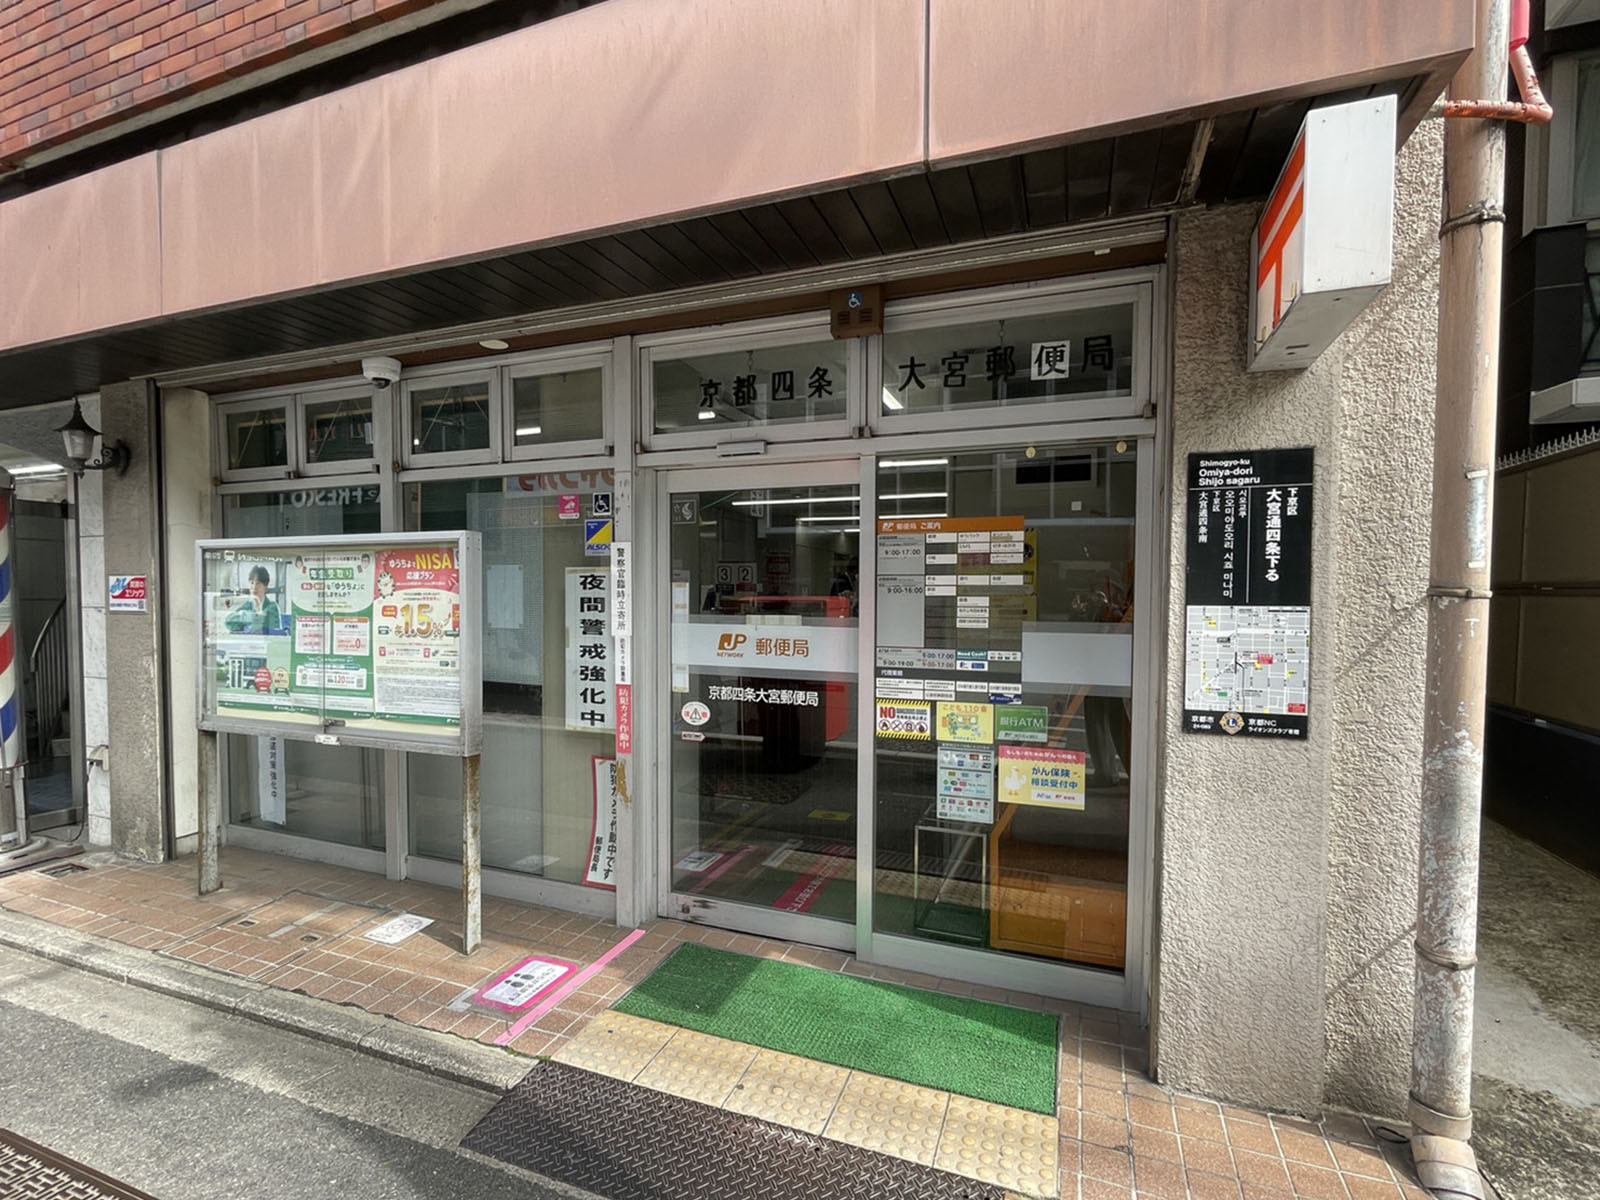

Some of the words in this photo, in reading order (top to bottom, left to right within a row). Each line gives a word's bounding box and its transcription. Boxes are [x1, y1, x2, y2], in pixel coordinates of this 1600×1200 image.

[700, 366, 833, 408] 京都四条
[898, 334, 1115, 393] 大宮郵便局
[1199, 466, 1253, 478] Omiya-dori
[1200, 458, 1250, 468] Shimogyo-ku
[1199, 477, 1224, 488] Shijo
[1226, 476, 1260, 487] sagaru
[1286, 487, 1299, 516] 下京区
[1265, 488, 1283, 582] 大宮通四条下る
[720, 567, 729, 581] 3
[742, 567, 750, 581] 2
[1223, 572, 1233, 598] 미나미
[579, 573, 606, 726] 夜間警戒強化中
[717, 633, 748, 651] JP
[755, 637, 809, 658] 郵便局
[708, 685, 819, 706] 京都四条大宮郵便局
[880, 706, 896, 719] NO
[1031, 766, 1070, 779] がん保険
